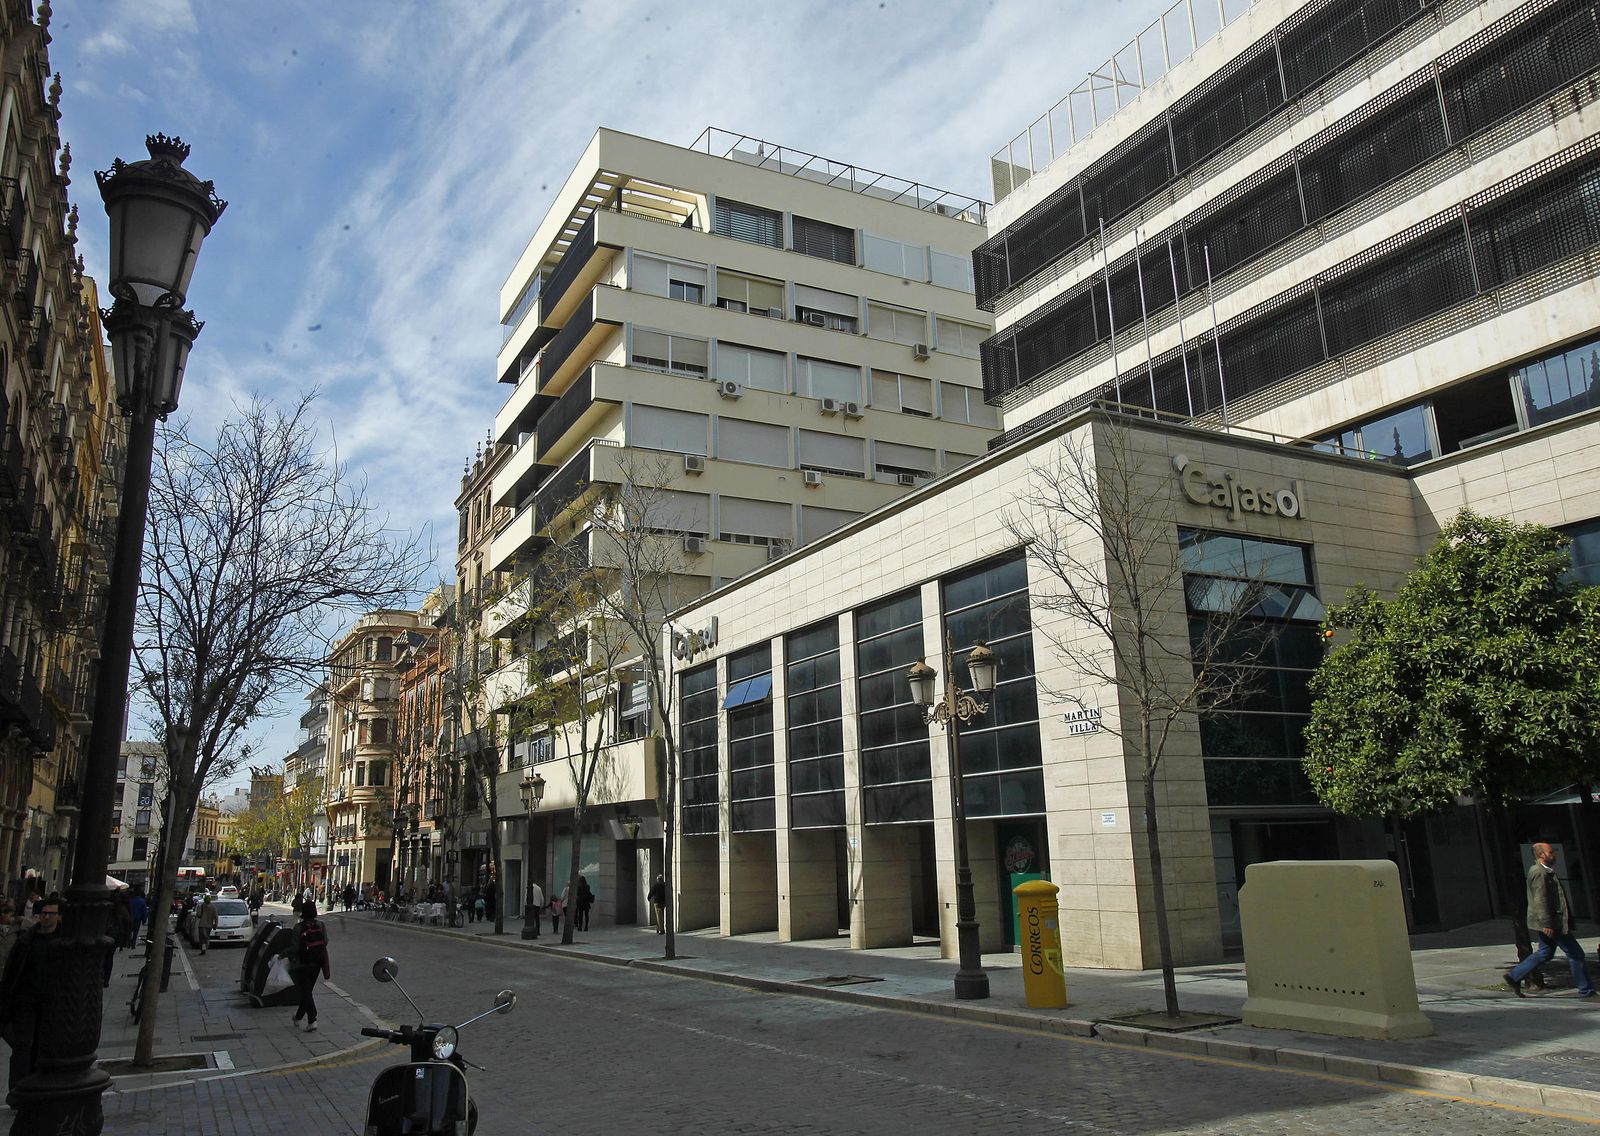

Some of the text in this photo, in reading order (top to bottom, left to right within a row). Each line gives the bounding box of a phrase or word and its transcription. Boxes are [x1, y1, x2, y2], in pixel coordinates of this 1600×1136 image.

[1172, 453, 1306, 522] Cajasol
[1063, 707, 1100, 722] MARTIN
[1026, 905, 1044, 976] CORREOS
